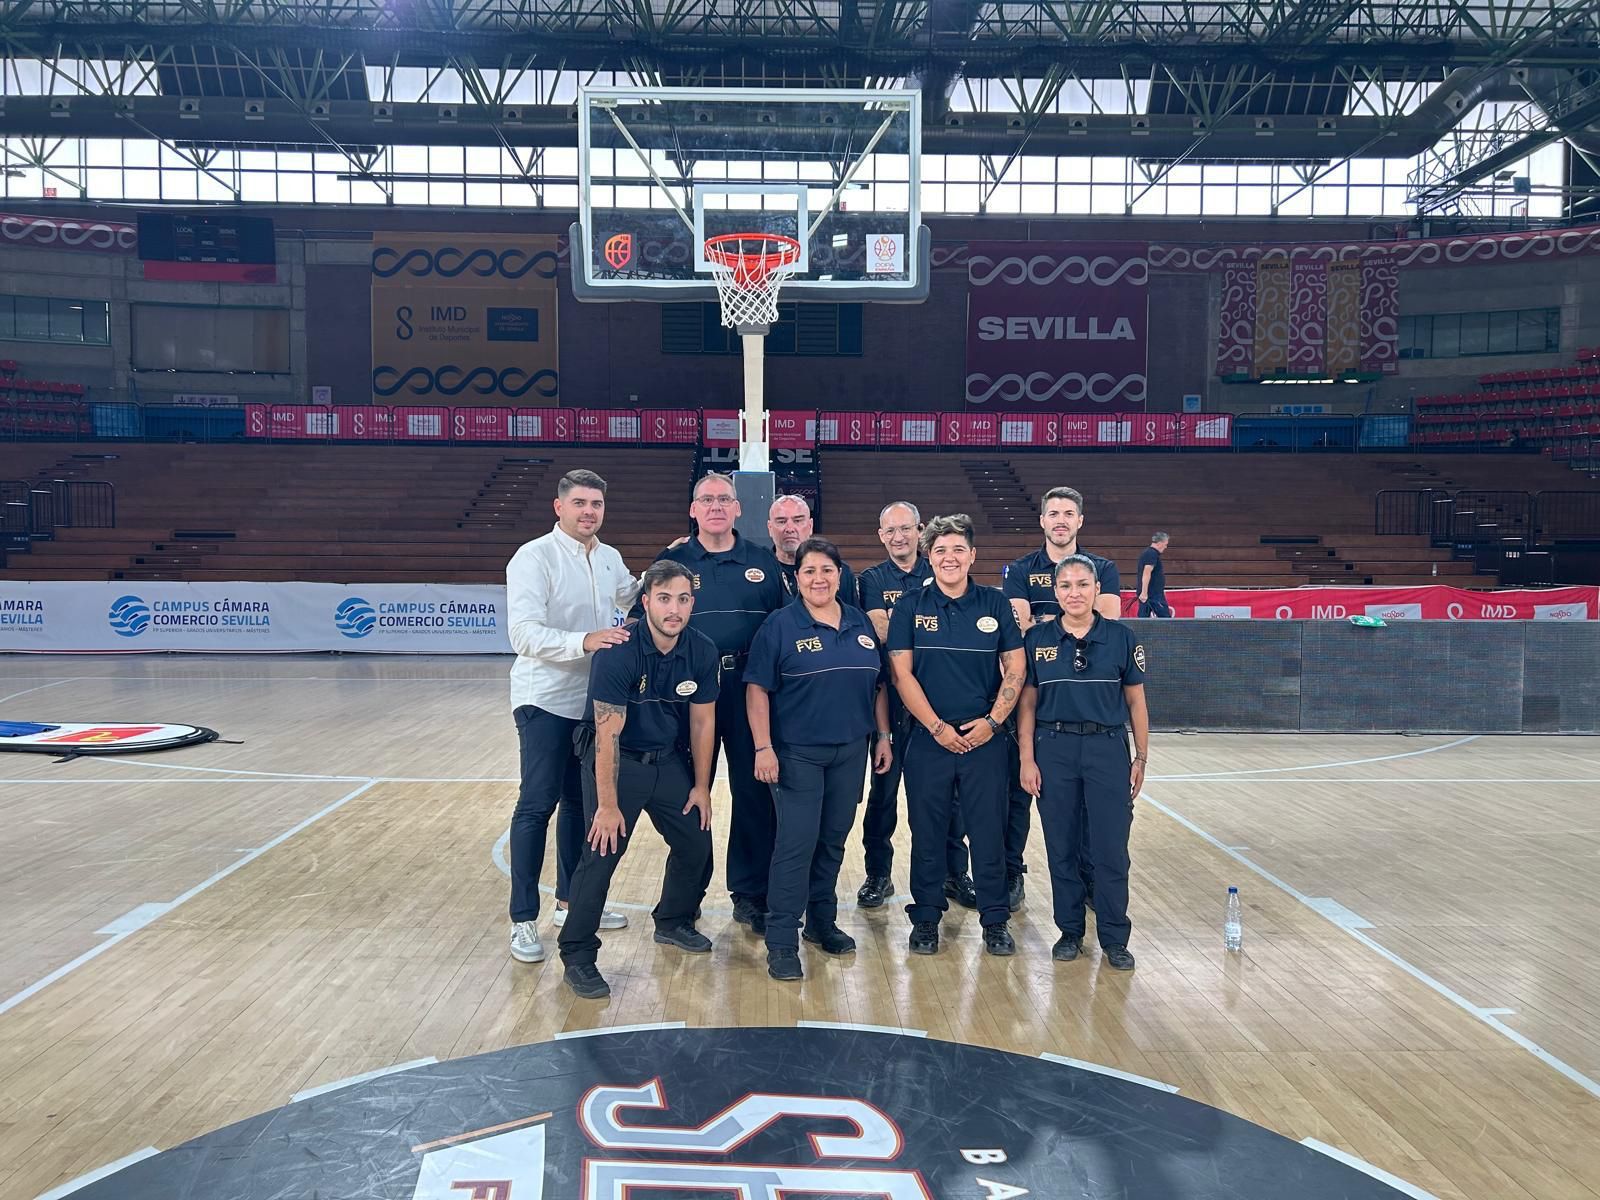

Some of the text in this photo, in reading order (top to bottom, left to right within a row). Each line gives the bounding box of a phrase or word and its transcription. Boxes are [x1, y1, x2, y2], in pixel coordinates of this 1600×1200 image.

[1260, 262, 1289, 270] SEVILLA
[1363, 257, 1395, 267] SEVILLA
[431, 306, 467, 321] IMD
[977, 315, 1137, 341] SEVILLA
[273, 412, 295, 422] IMD
[476, 415, 497, 424] IMD
[774, 419, 796, 429] IMD
[1067, 421, 1088, 430] IMD
[1030, 576, 1052, 587] FVS
[153, 598, 270, 612] CAMPUS CÁMARA
[379, 600, 497, 614] CAMPUS CÁMARA
[1311, 605, 1346, 619] IMD
[1481, 604, 1517, 619] IMD
[153, 614, 270, 626] COMERCIO SEVILLA
[379, 616, 497, 628] COMERCIO SEVILLA
[915, 618, 938, 629] FVS
[796, 639, 823, 653] FVS
[1035, 650, 1058, 661] FVS
